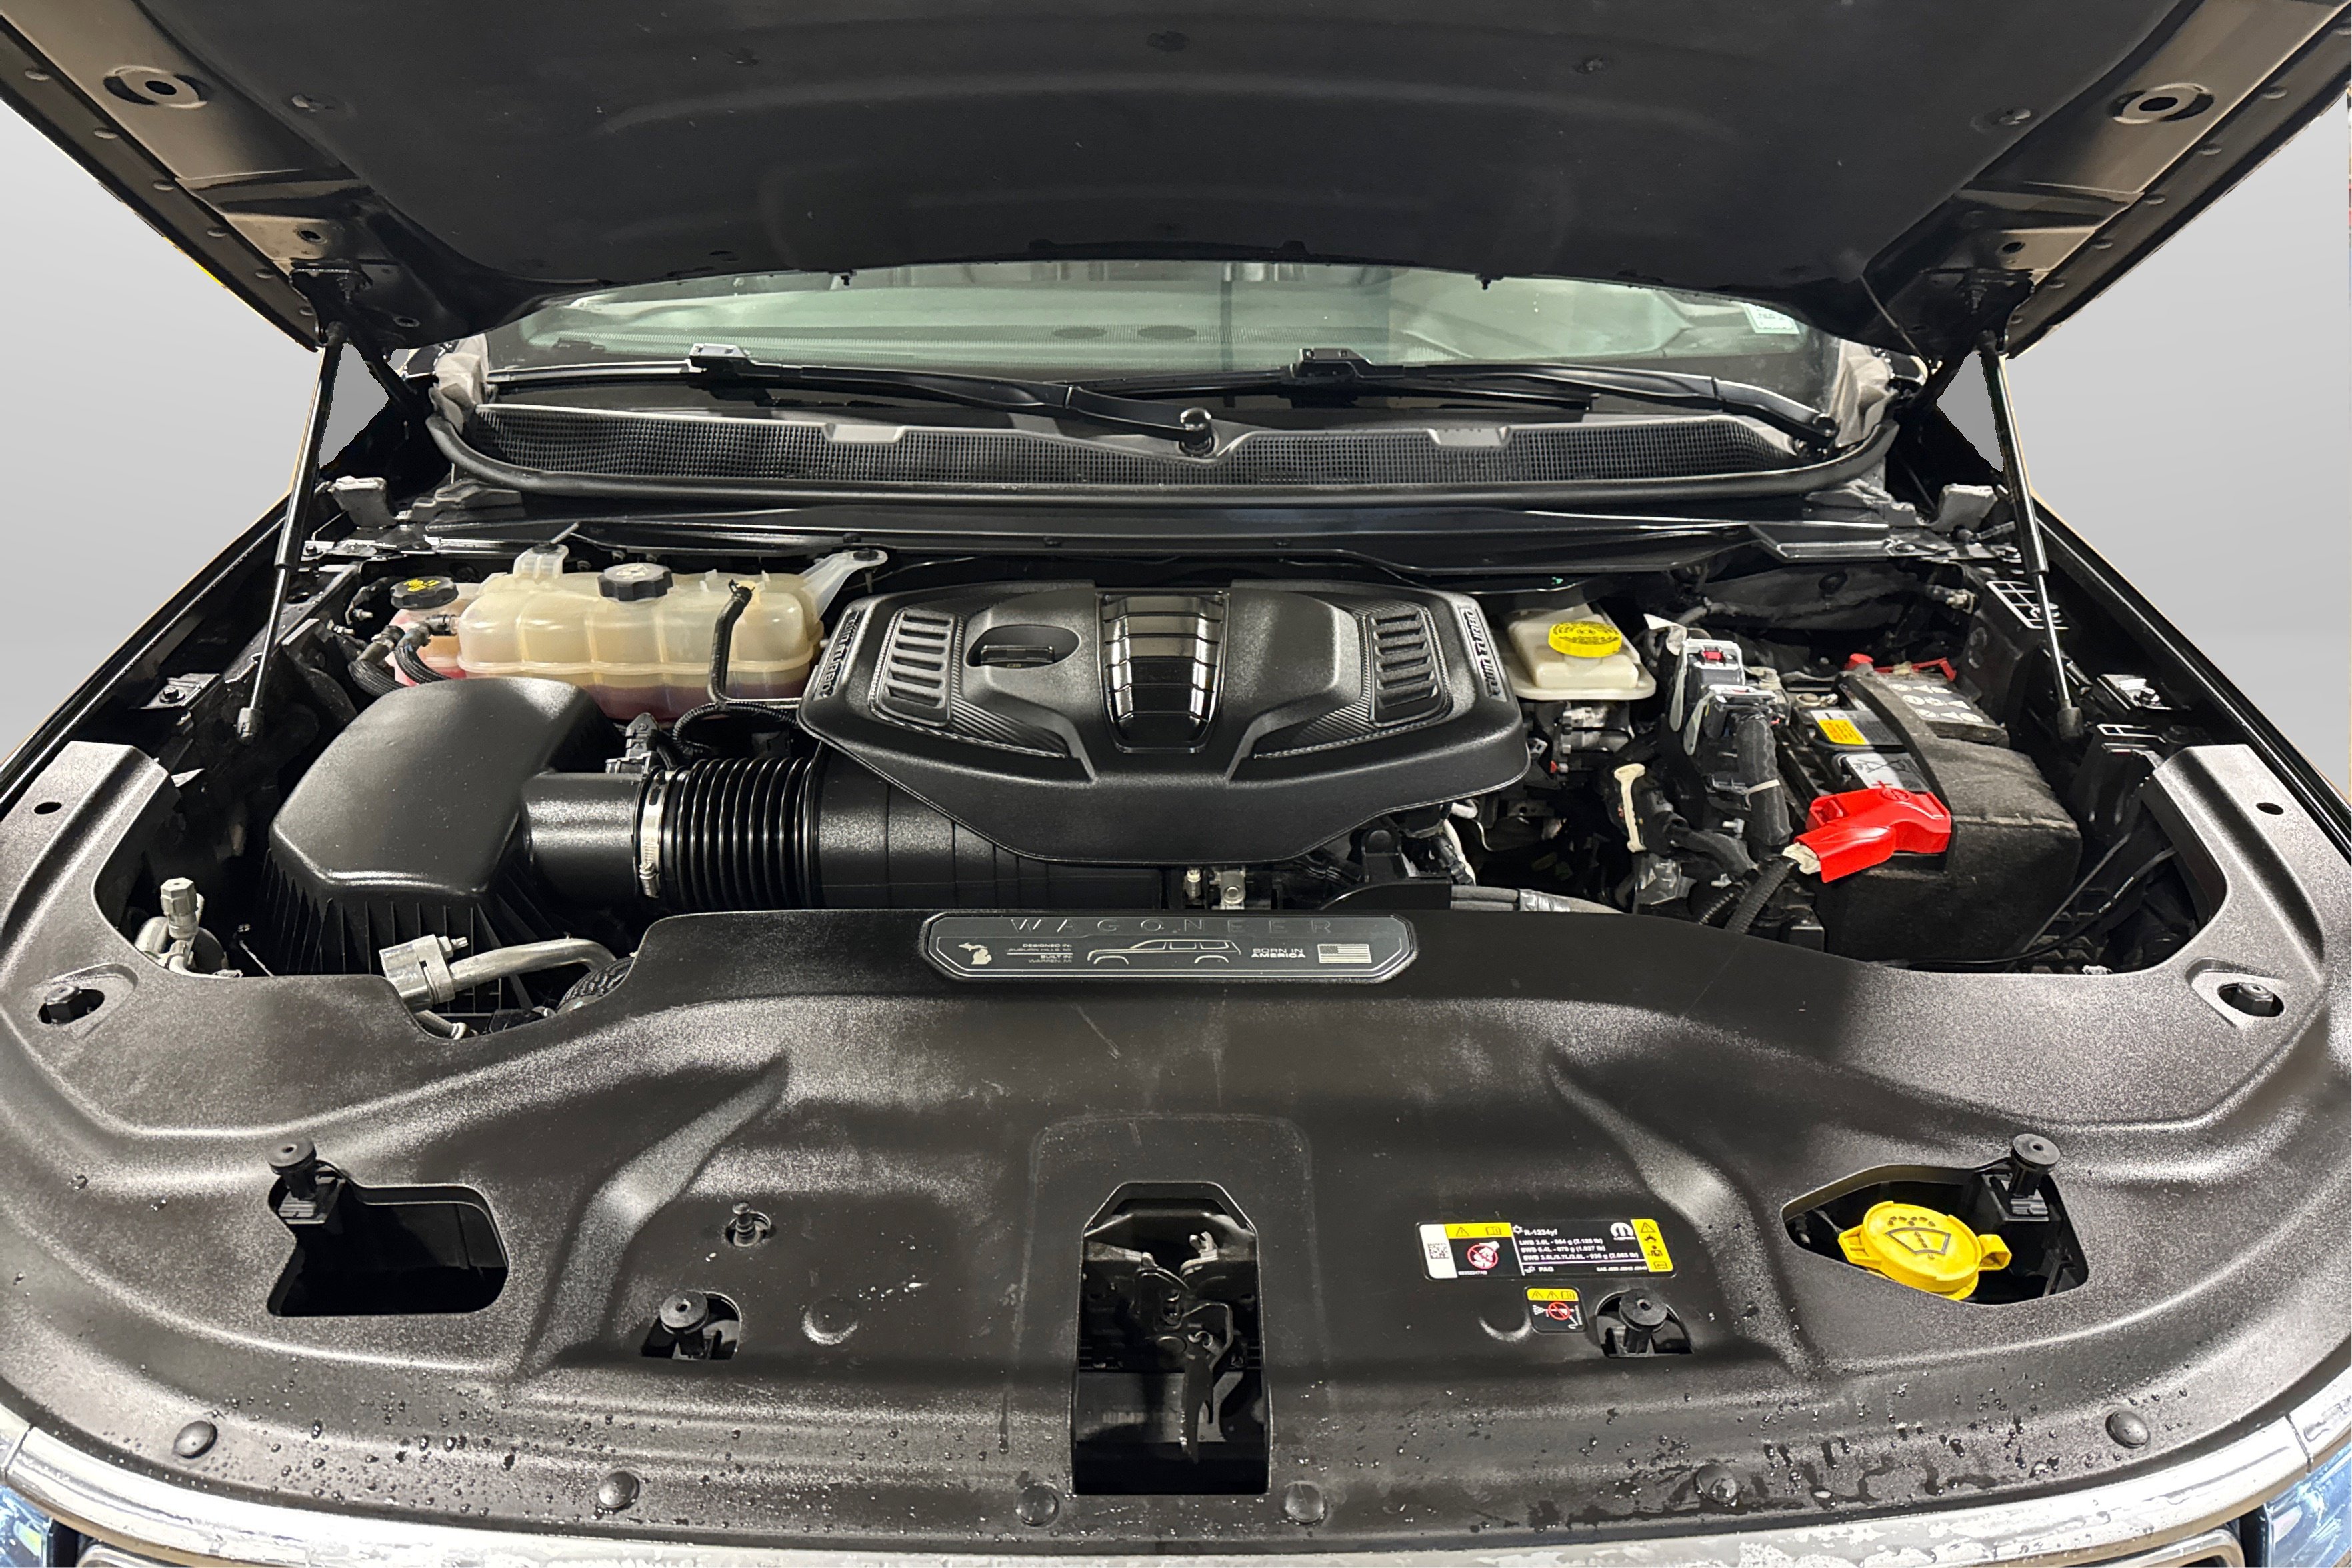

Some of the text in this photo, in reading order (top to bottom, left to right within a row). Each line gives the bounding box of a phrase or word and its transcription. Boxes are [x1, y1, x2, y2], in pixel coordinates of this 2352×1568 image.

[1464, 609, 1488, 657] TURBO
[820, 644, 847, 693] TURBO
[1011, 919, 1331, 933] WAGONEER
[1523, 1229, 1558, 1237] R-1234yf
